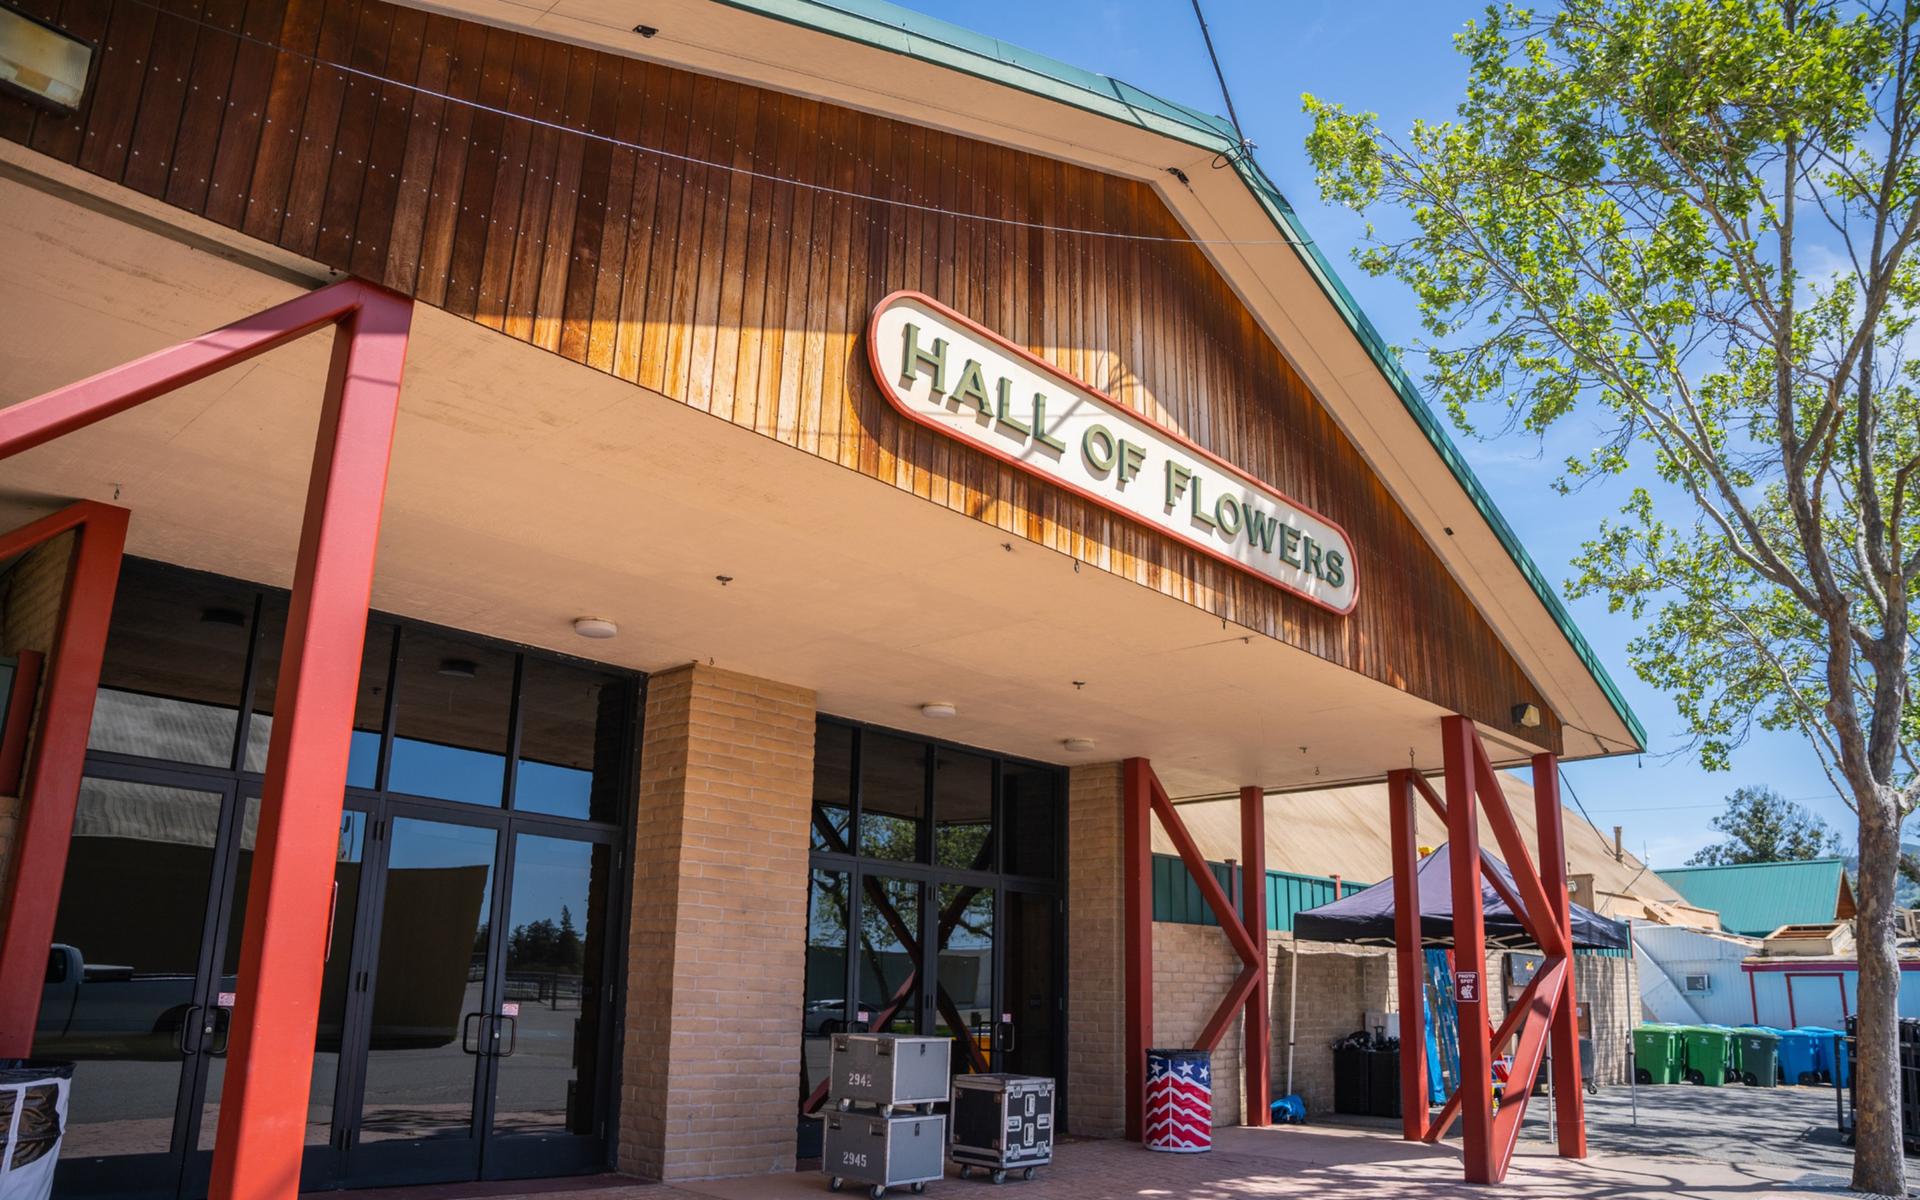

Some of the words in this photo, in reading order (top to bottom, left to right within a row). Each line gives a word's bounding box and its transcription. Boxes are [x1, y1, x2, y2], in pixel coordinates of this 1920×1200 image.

[902, 322, 1066, 454] HALL
[1082, 423, 1146, 484] OF
[1164, 459, 1346, 588] FLOWERS
[842, 1151, 867, 1168] 2945
